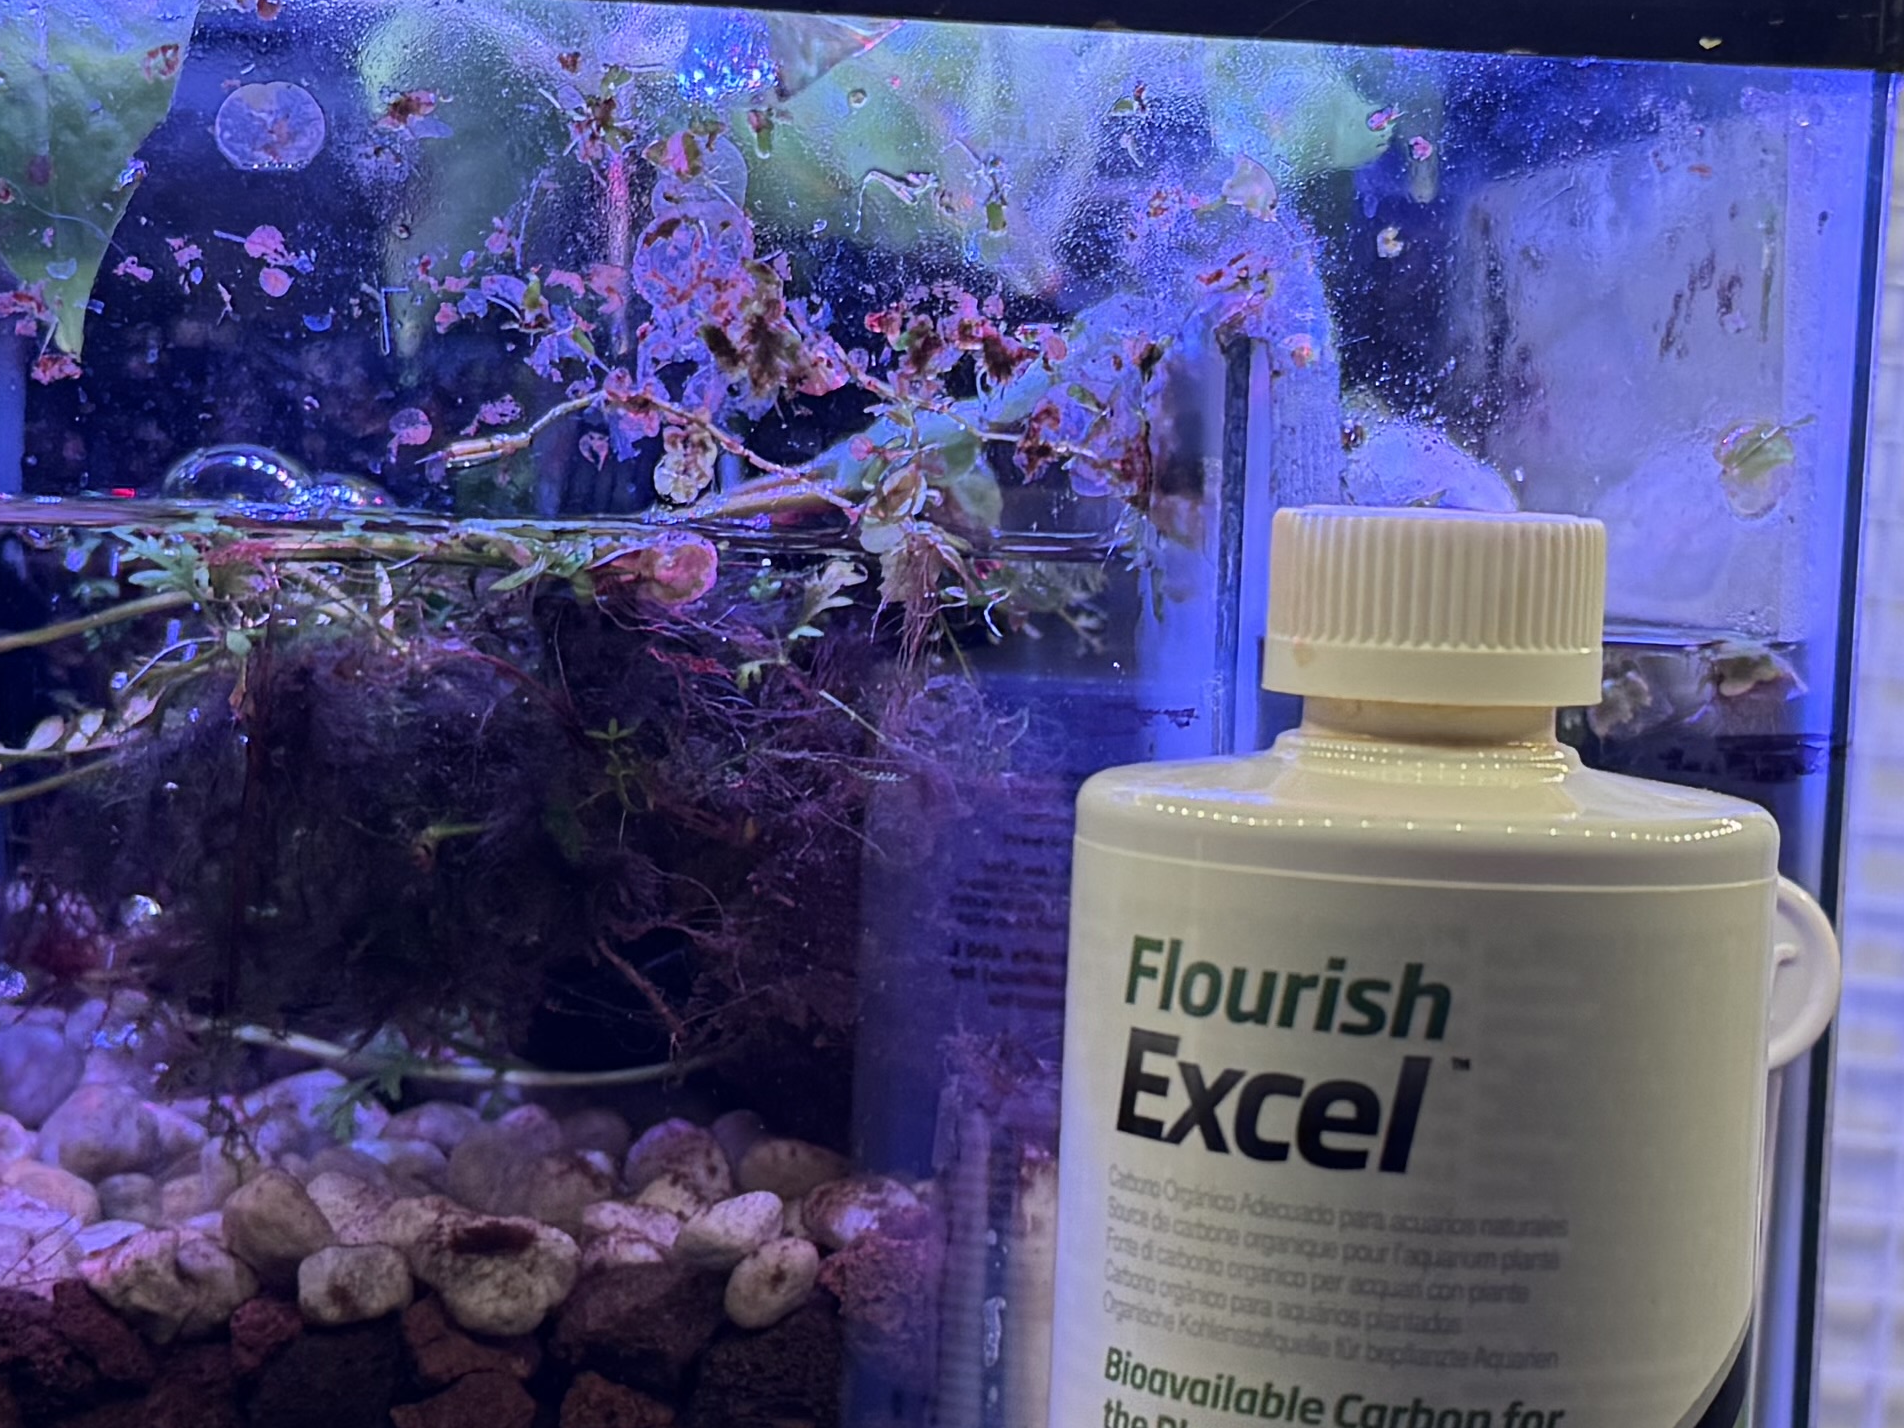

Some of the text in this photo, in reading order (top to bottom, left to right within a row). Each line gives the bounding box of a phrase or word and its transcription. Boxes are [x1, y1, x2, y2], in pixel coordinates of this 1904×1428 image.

[1124, 933, 1452, 1041] Flourish
[1151, 1209, 1171, 1234] de
[1341, 1242, 1390, 1266] pour
[1338, 1207, 1387, 1232] para
[1230, 1294, 1272, 1318] para
[1104, 1345, 1326, 1426] Bioavailable
